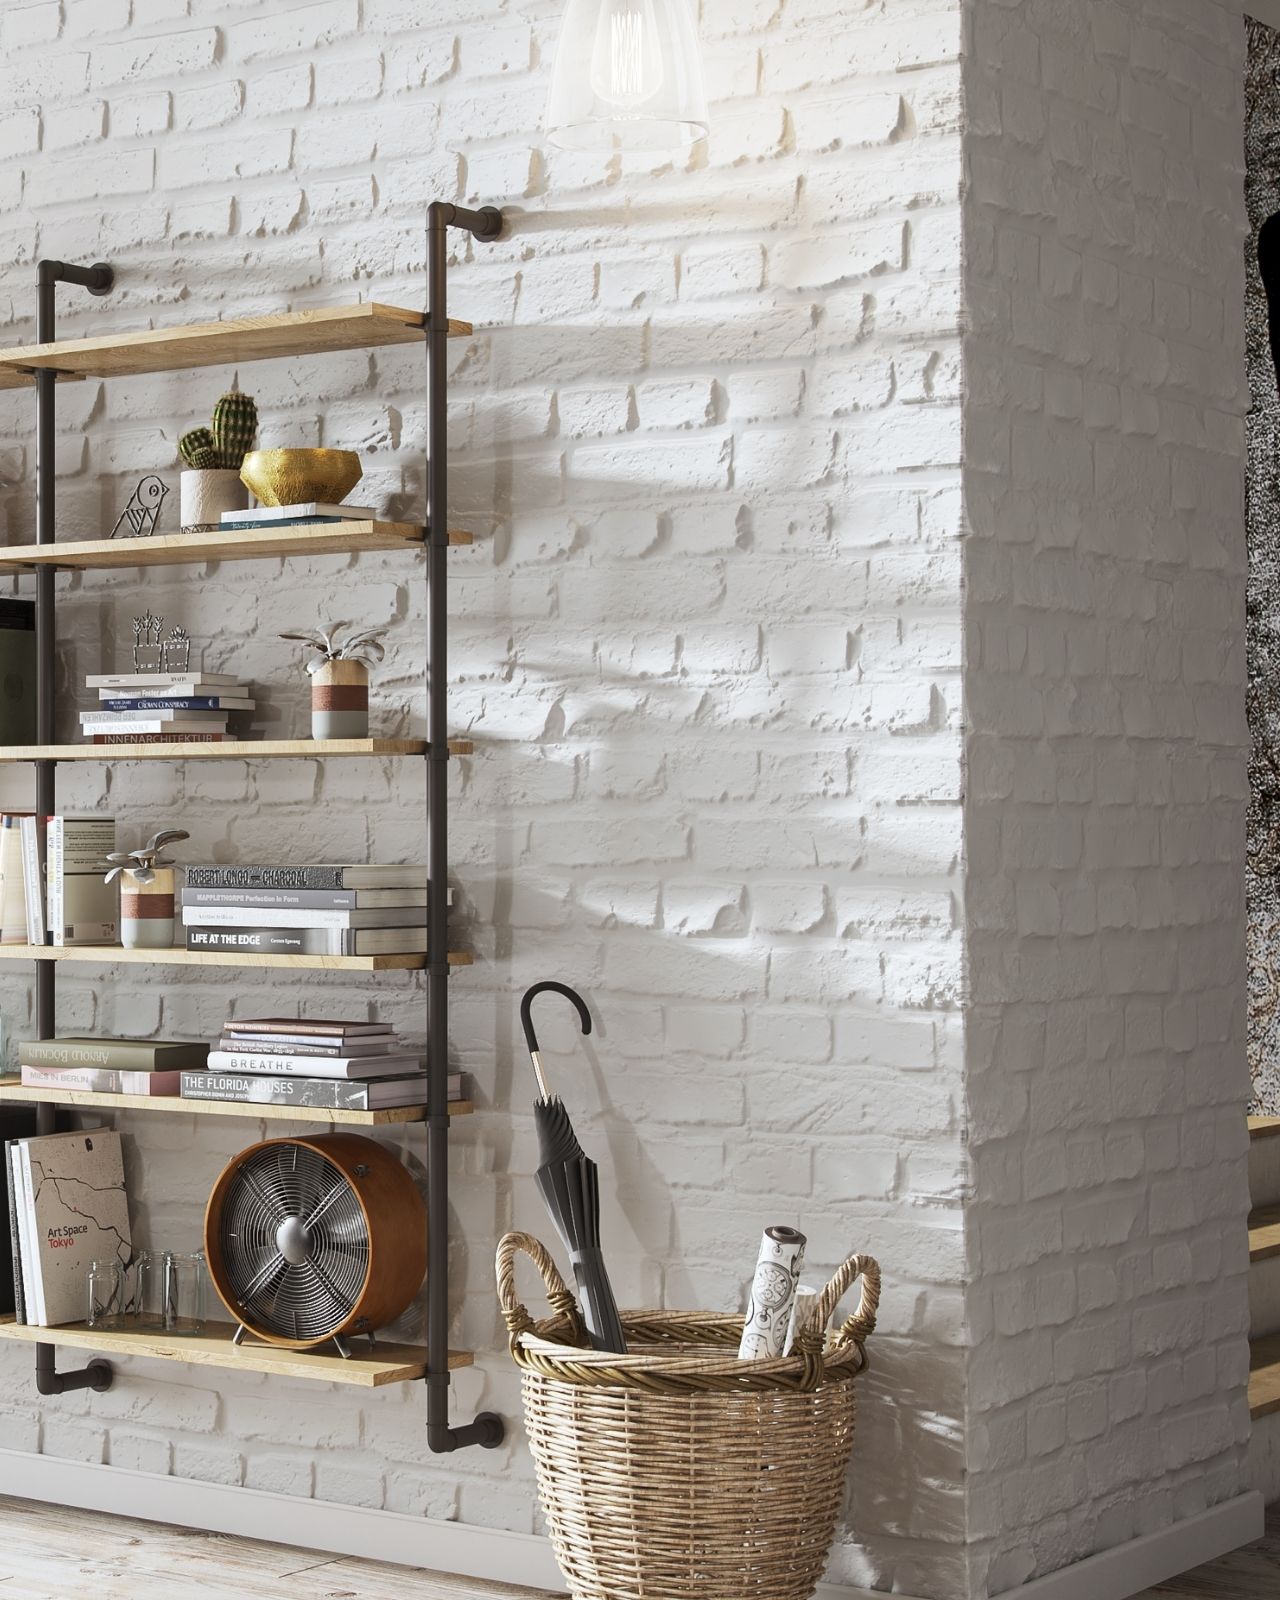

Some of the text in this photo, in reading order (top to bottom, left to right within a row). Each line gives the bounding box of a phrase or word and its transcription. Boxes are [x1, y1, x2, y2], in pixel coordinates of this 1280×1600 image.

[158, 701, 189, 709] CONSPIRACY
[104, 733, 213, 744] INNENARCHITEKTUR
[188, 869, 220, 886] ROBERT
[223, 869, 249, 886] LONGO
[262, 870, 307, 886] CHARCOAL
[196, 893, 245, 903] MAPPLETHORPE
[245, 894, 275, 903] Perfection
[283, 895, 299, 903] Form
[191, 933, 261, 945] LIFE AT THE EDGE
[72, 1051, 110, 1064] ARNOLD
[230, 1058, 293, 1071] BREATHE
[30, 1071, 89, 1083] MIES IN BERLIN
[184, 1076, 294, 1094] THE FLORIDA HOUSES
[47, 1224, 88, 1238] Art Space
[48, 1238, 74, 1249] Tokyo
